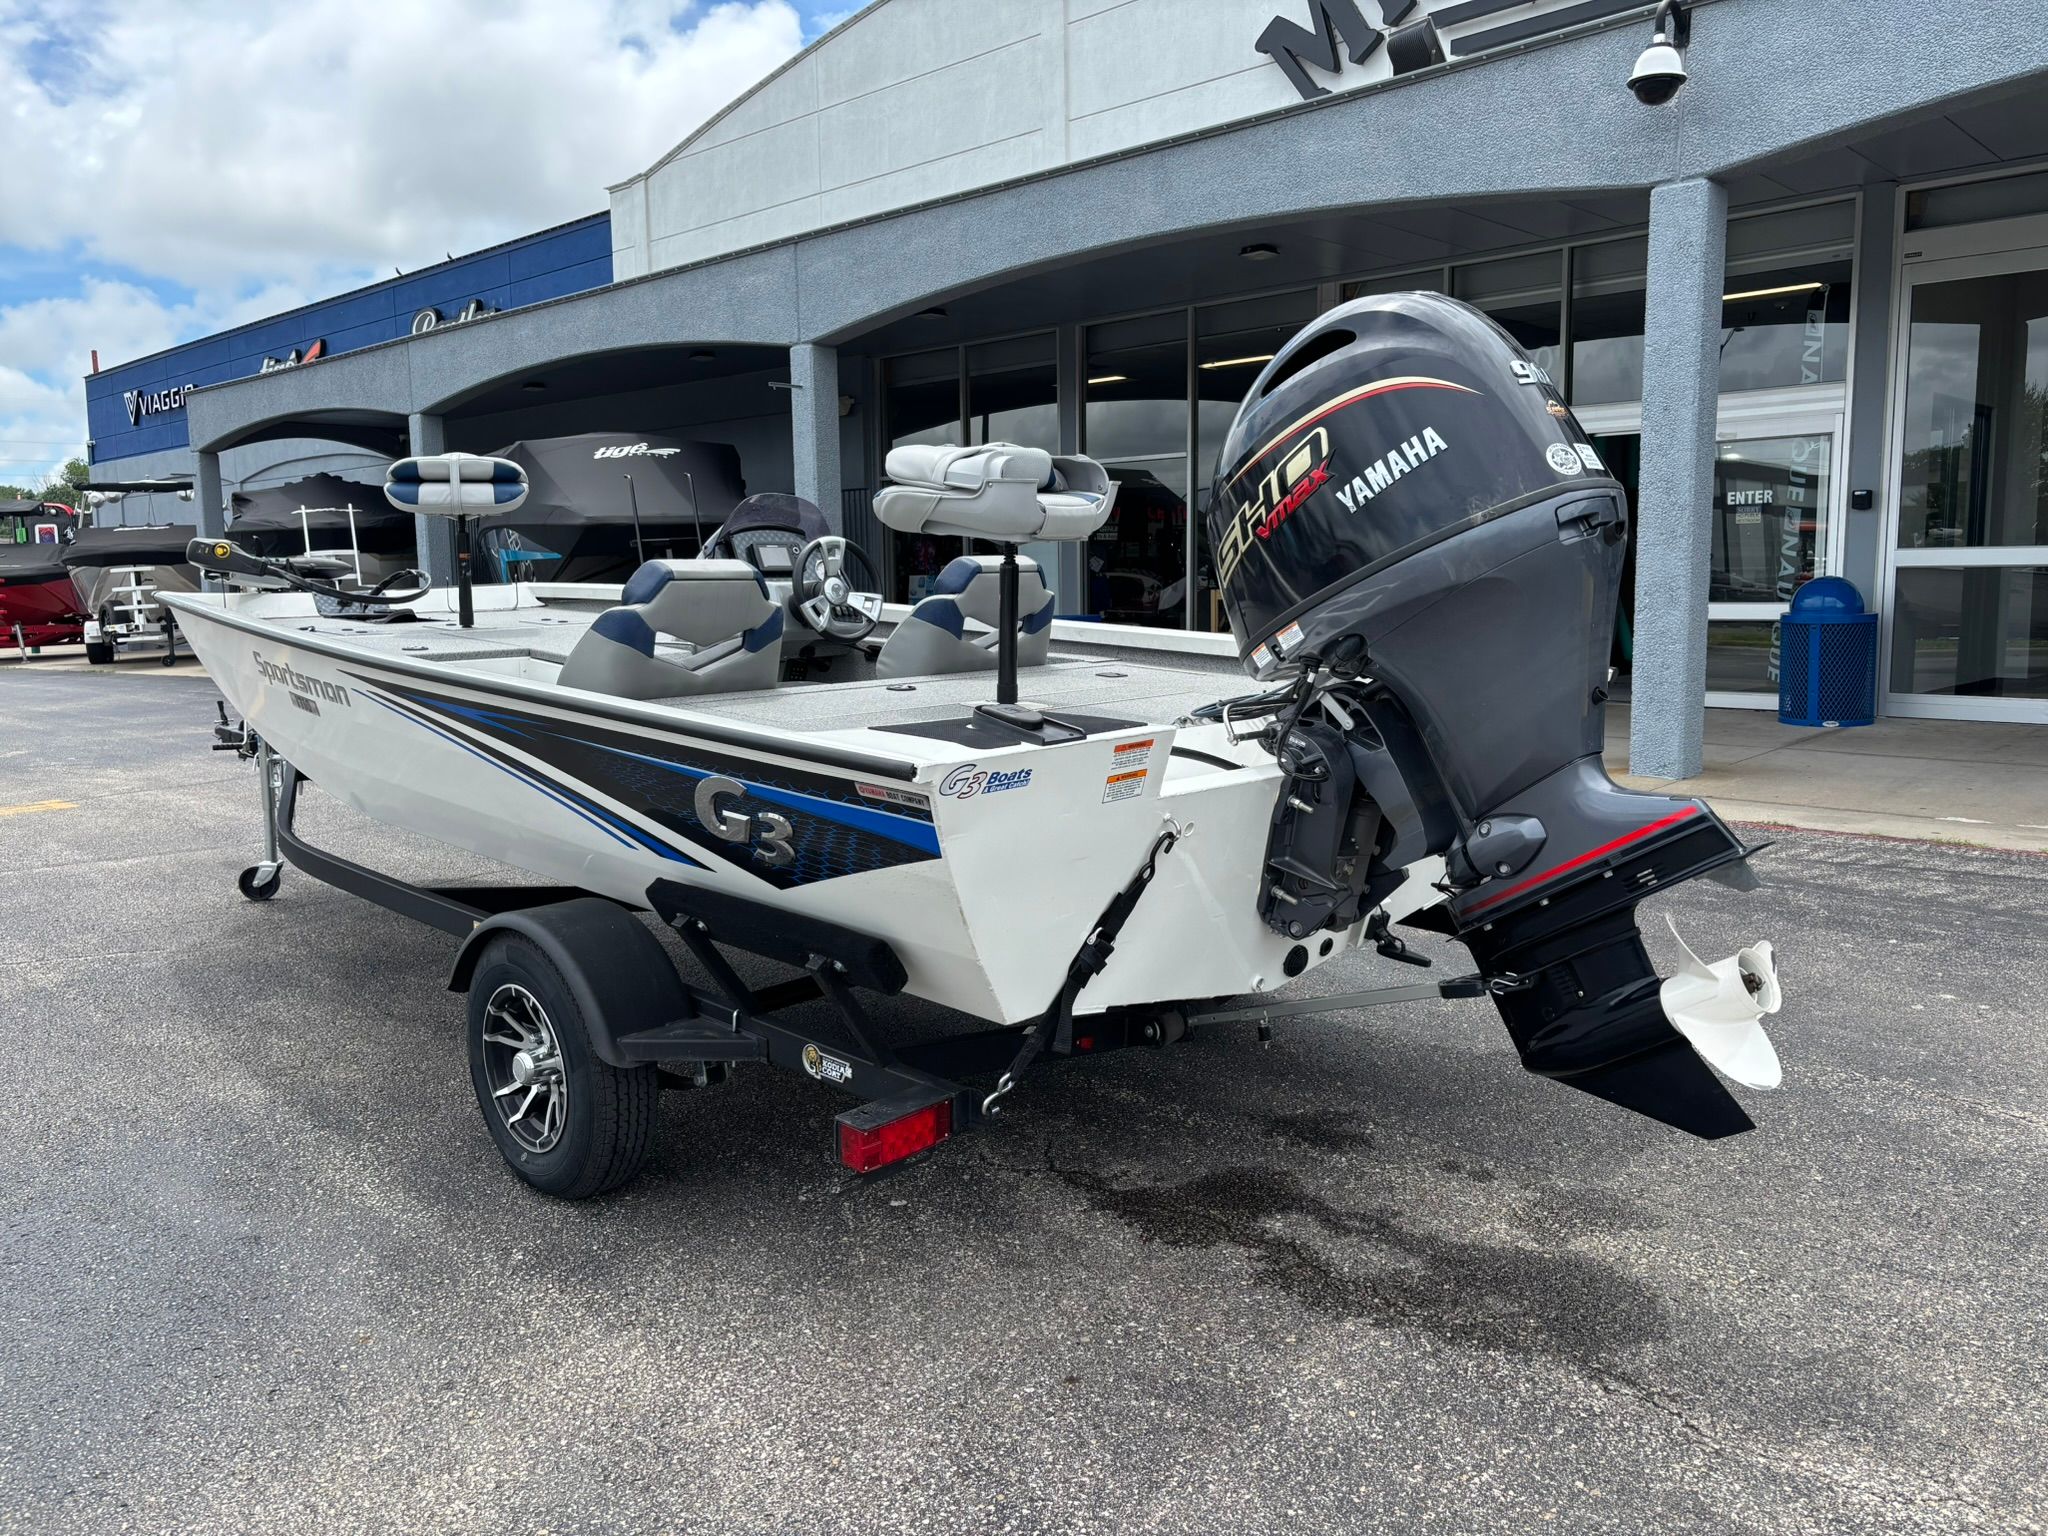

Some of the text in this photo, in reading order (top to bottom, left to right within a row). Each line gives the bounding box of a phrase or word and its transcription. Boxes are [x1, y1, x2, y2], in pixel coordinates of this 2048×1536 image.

[1254, 0, 1418, 100] M
[1335, 426, 1448, 514] YAMAHA
[1727, 489, 1773, 505] ENTER
[253, 651, 351, 707] Sportsman
[939, 763, 1032, 799] G3 Boats
[695, 776, 796, 866] G3
